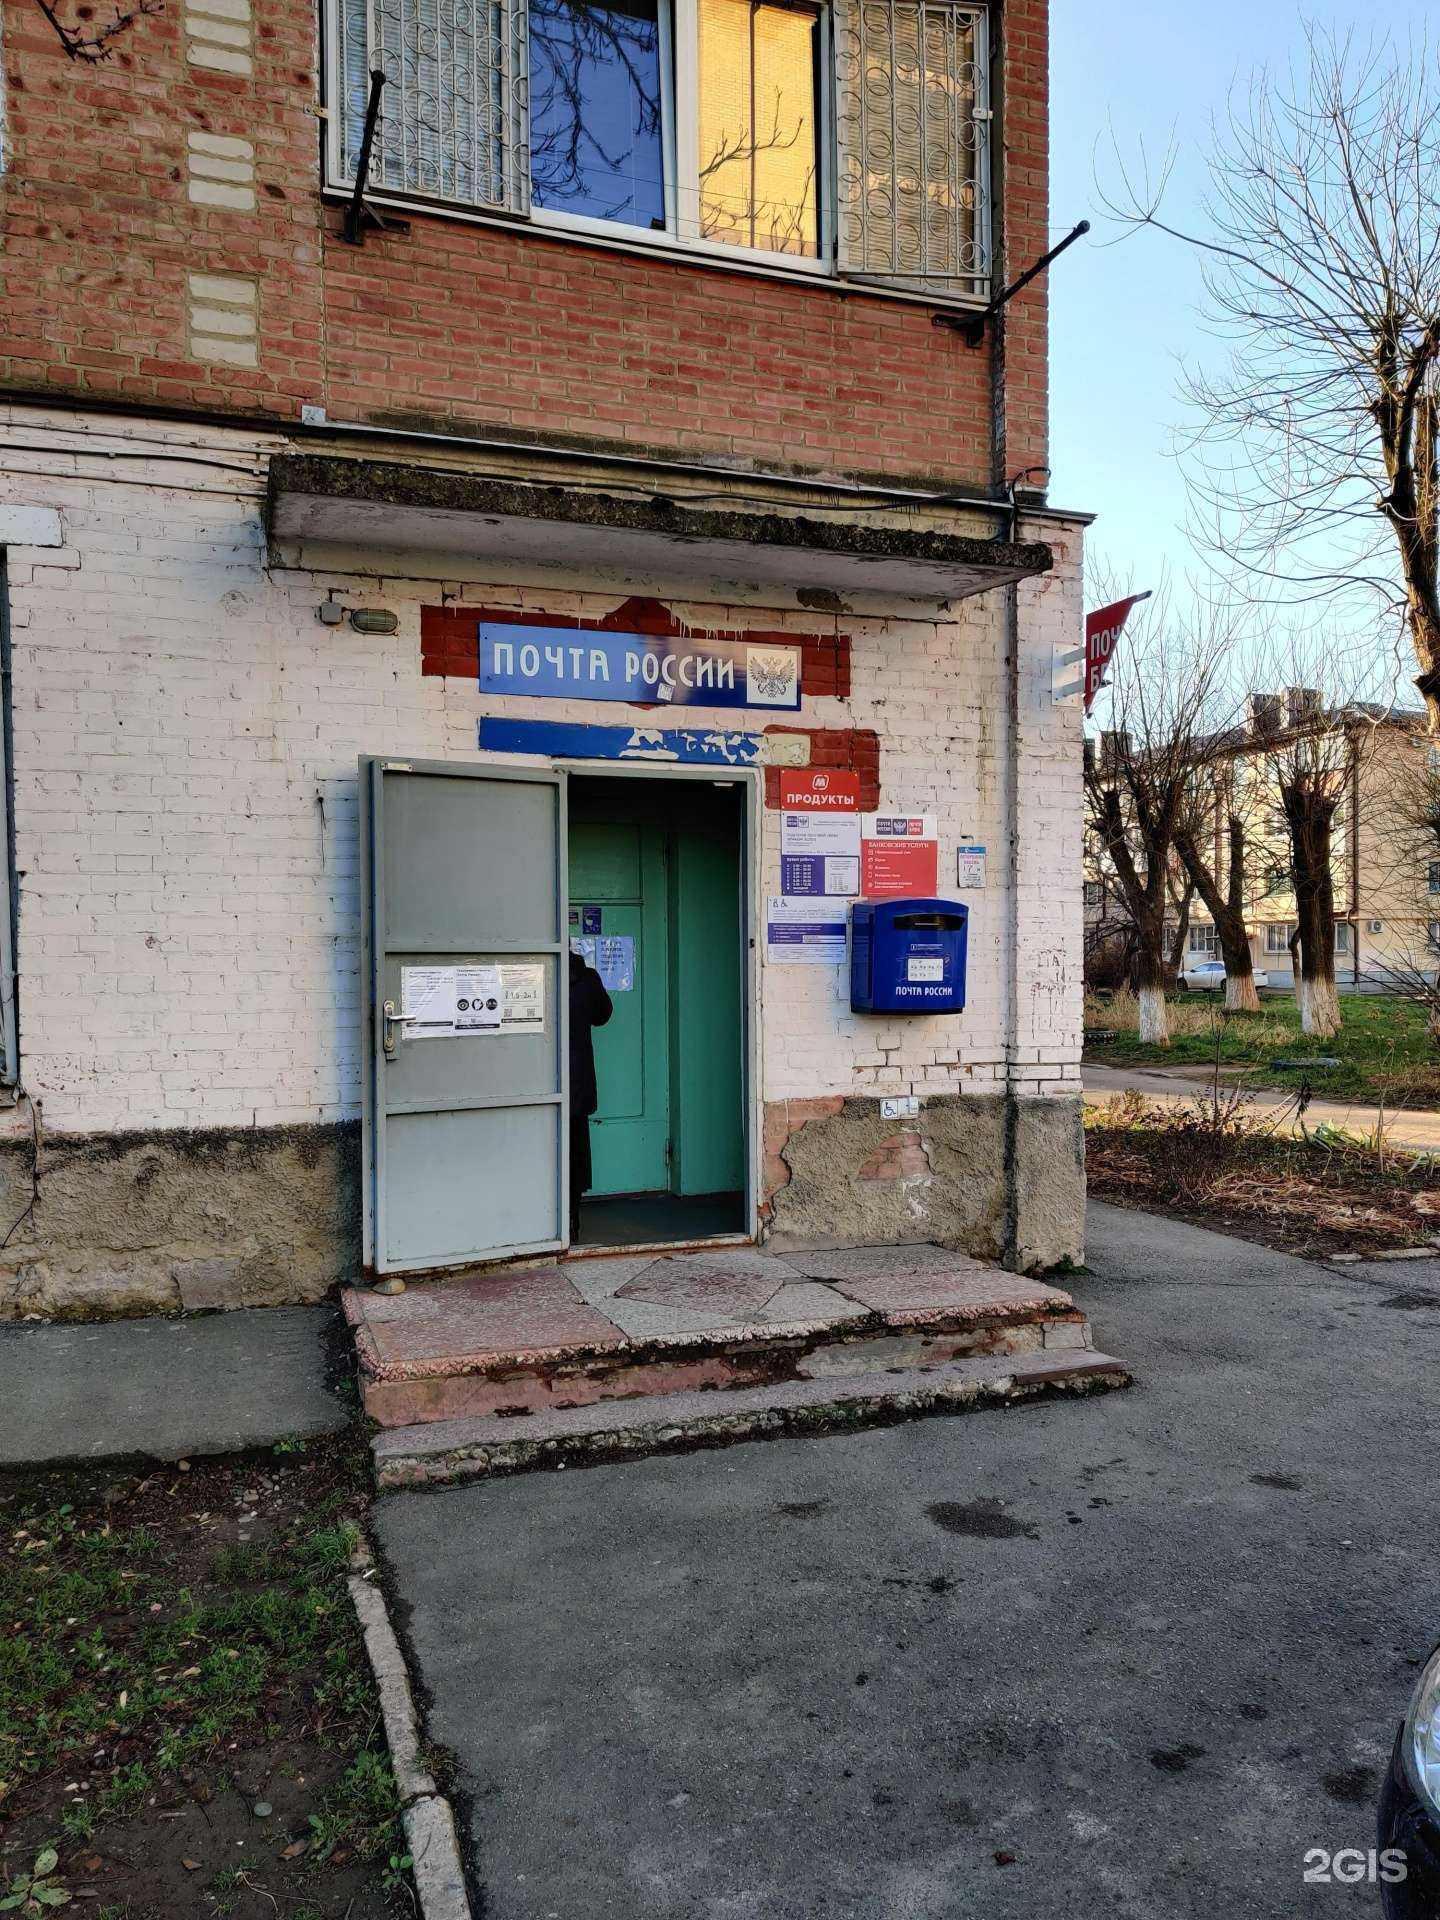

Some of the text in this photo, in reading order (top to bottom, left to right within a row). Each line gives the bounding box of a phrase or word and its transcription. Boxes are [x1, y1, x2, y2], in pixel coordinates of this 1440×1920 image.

[493, 642, 736, 690] ПОЧТА РОССИИ
[786, 793, 855, 805] ПРОДУКТЫ
[895, 986, 953, 996] ПОЧТА РОССИИ
